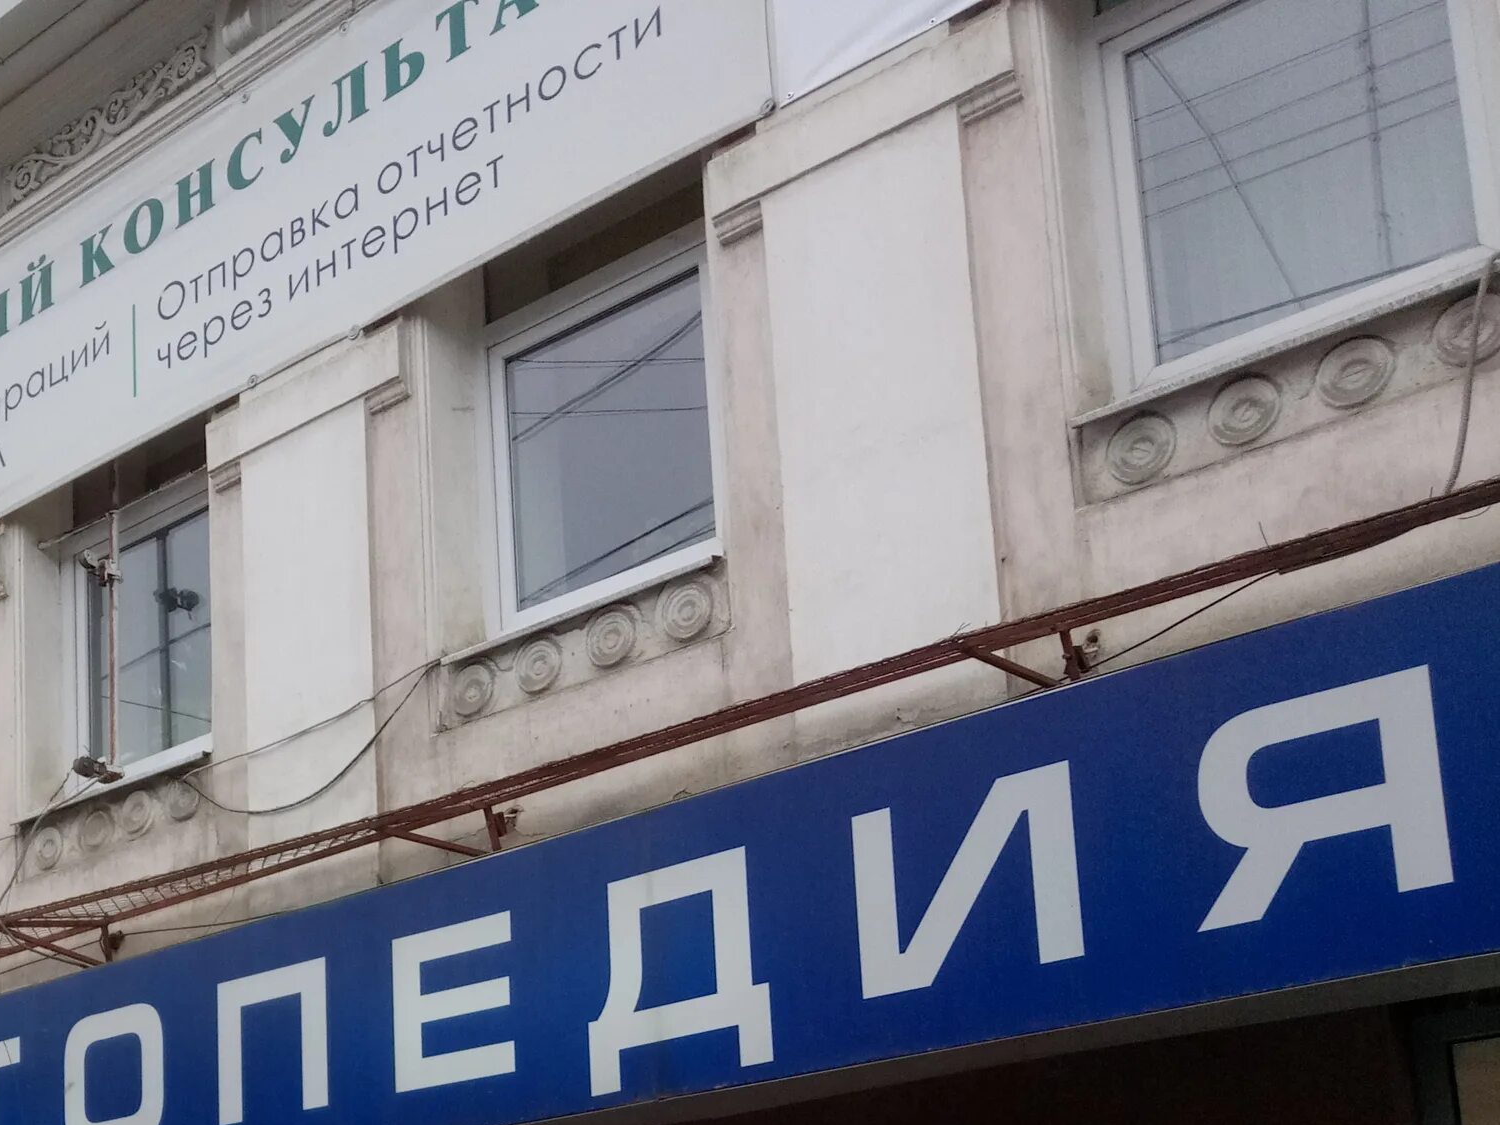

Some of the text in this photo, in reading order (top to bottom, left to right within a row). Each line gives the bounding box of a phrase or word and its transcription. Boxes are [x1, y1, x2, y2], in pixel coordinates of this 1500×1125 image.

[156, 155, 505, 370] через интернет
[157, 4, 662, 321] Отправка отчетности
